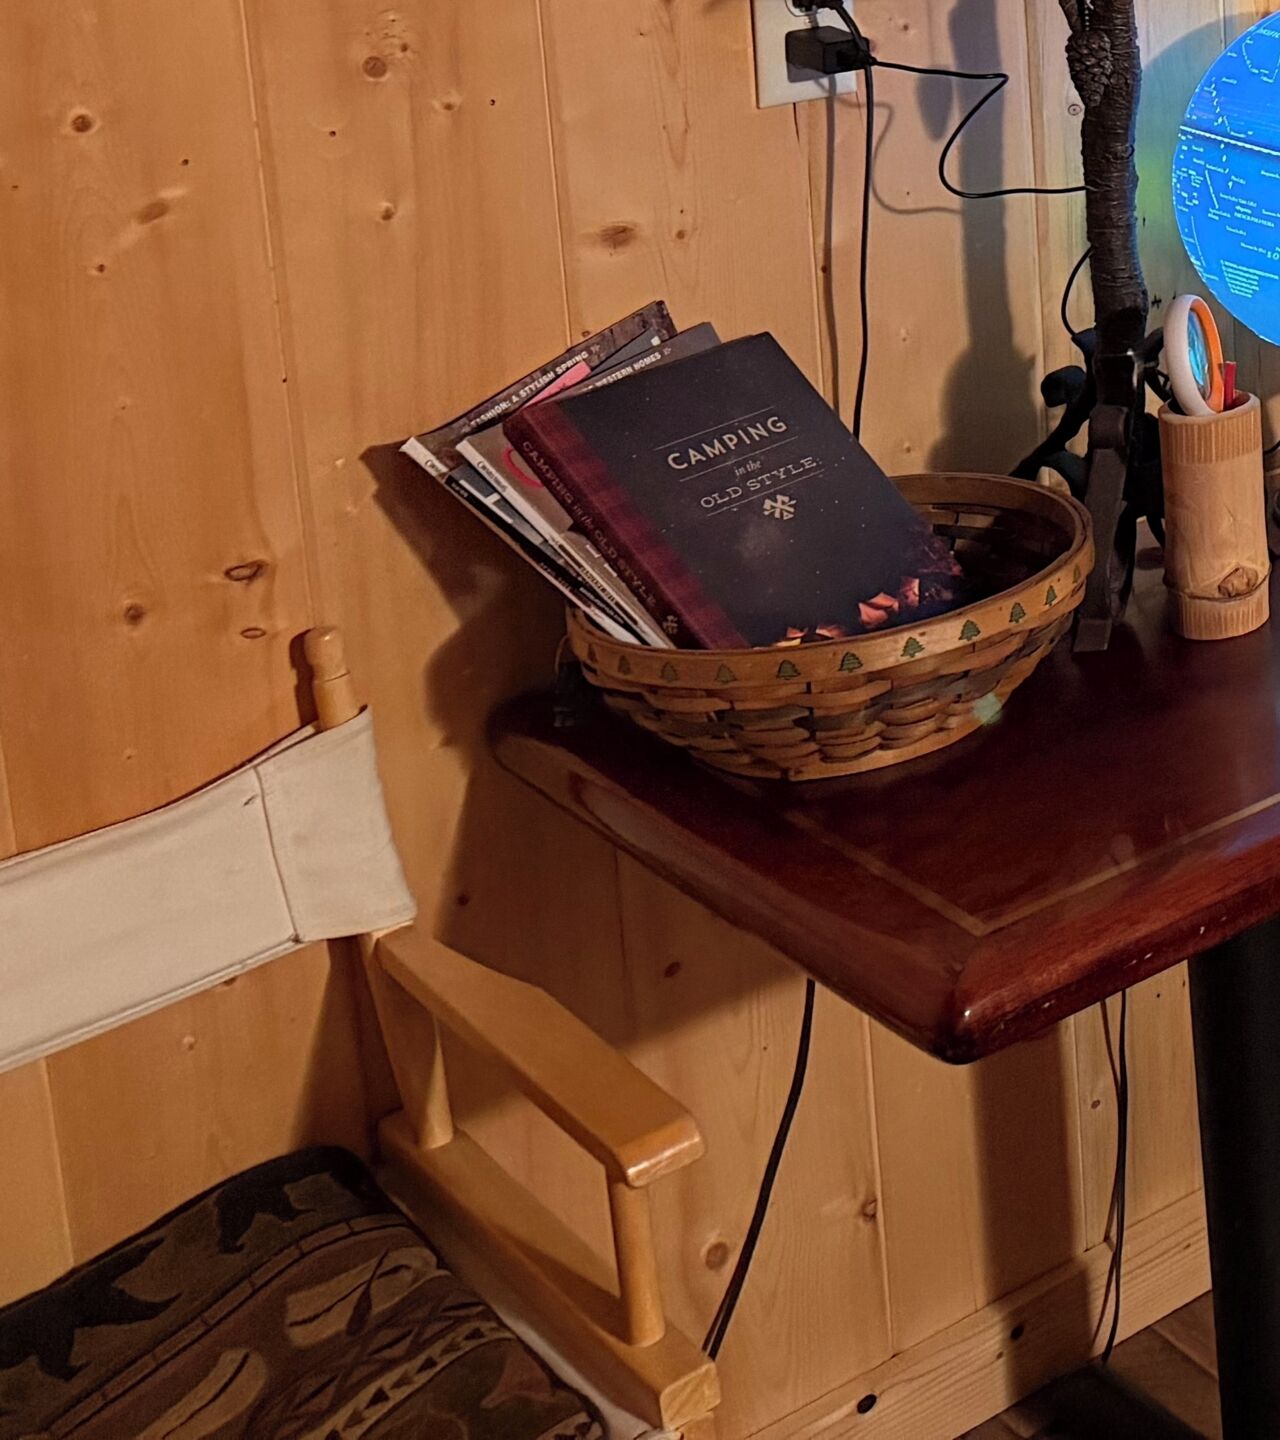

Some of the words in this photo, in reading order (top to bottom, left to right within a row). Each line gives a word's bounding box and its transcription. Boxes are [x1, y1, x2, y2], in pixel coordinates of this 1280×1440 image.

[511, 394, 519, 404] A
[519, 370, 555, 399] STYLISH
[555, 351, 590, 376] SPRING
[633, 351, 662, 371] HOMES
[667, 416, 788, 470] CAMPING
[522, 441, 574, 504] CAMPING
[734, 466, 747, 478] in
[746, 459, 762, 473] the
[700, 486, 743, 508] OLD
